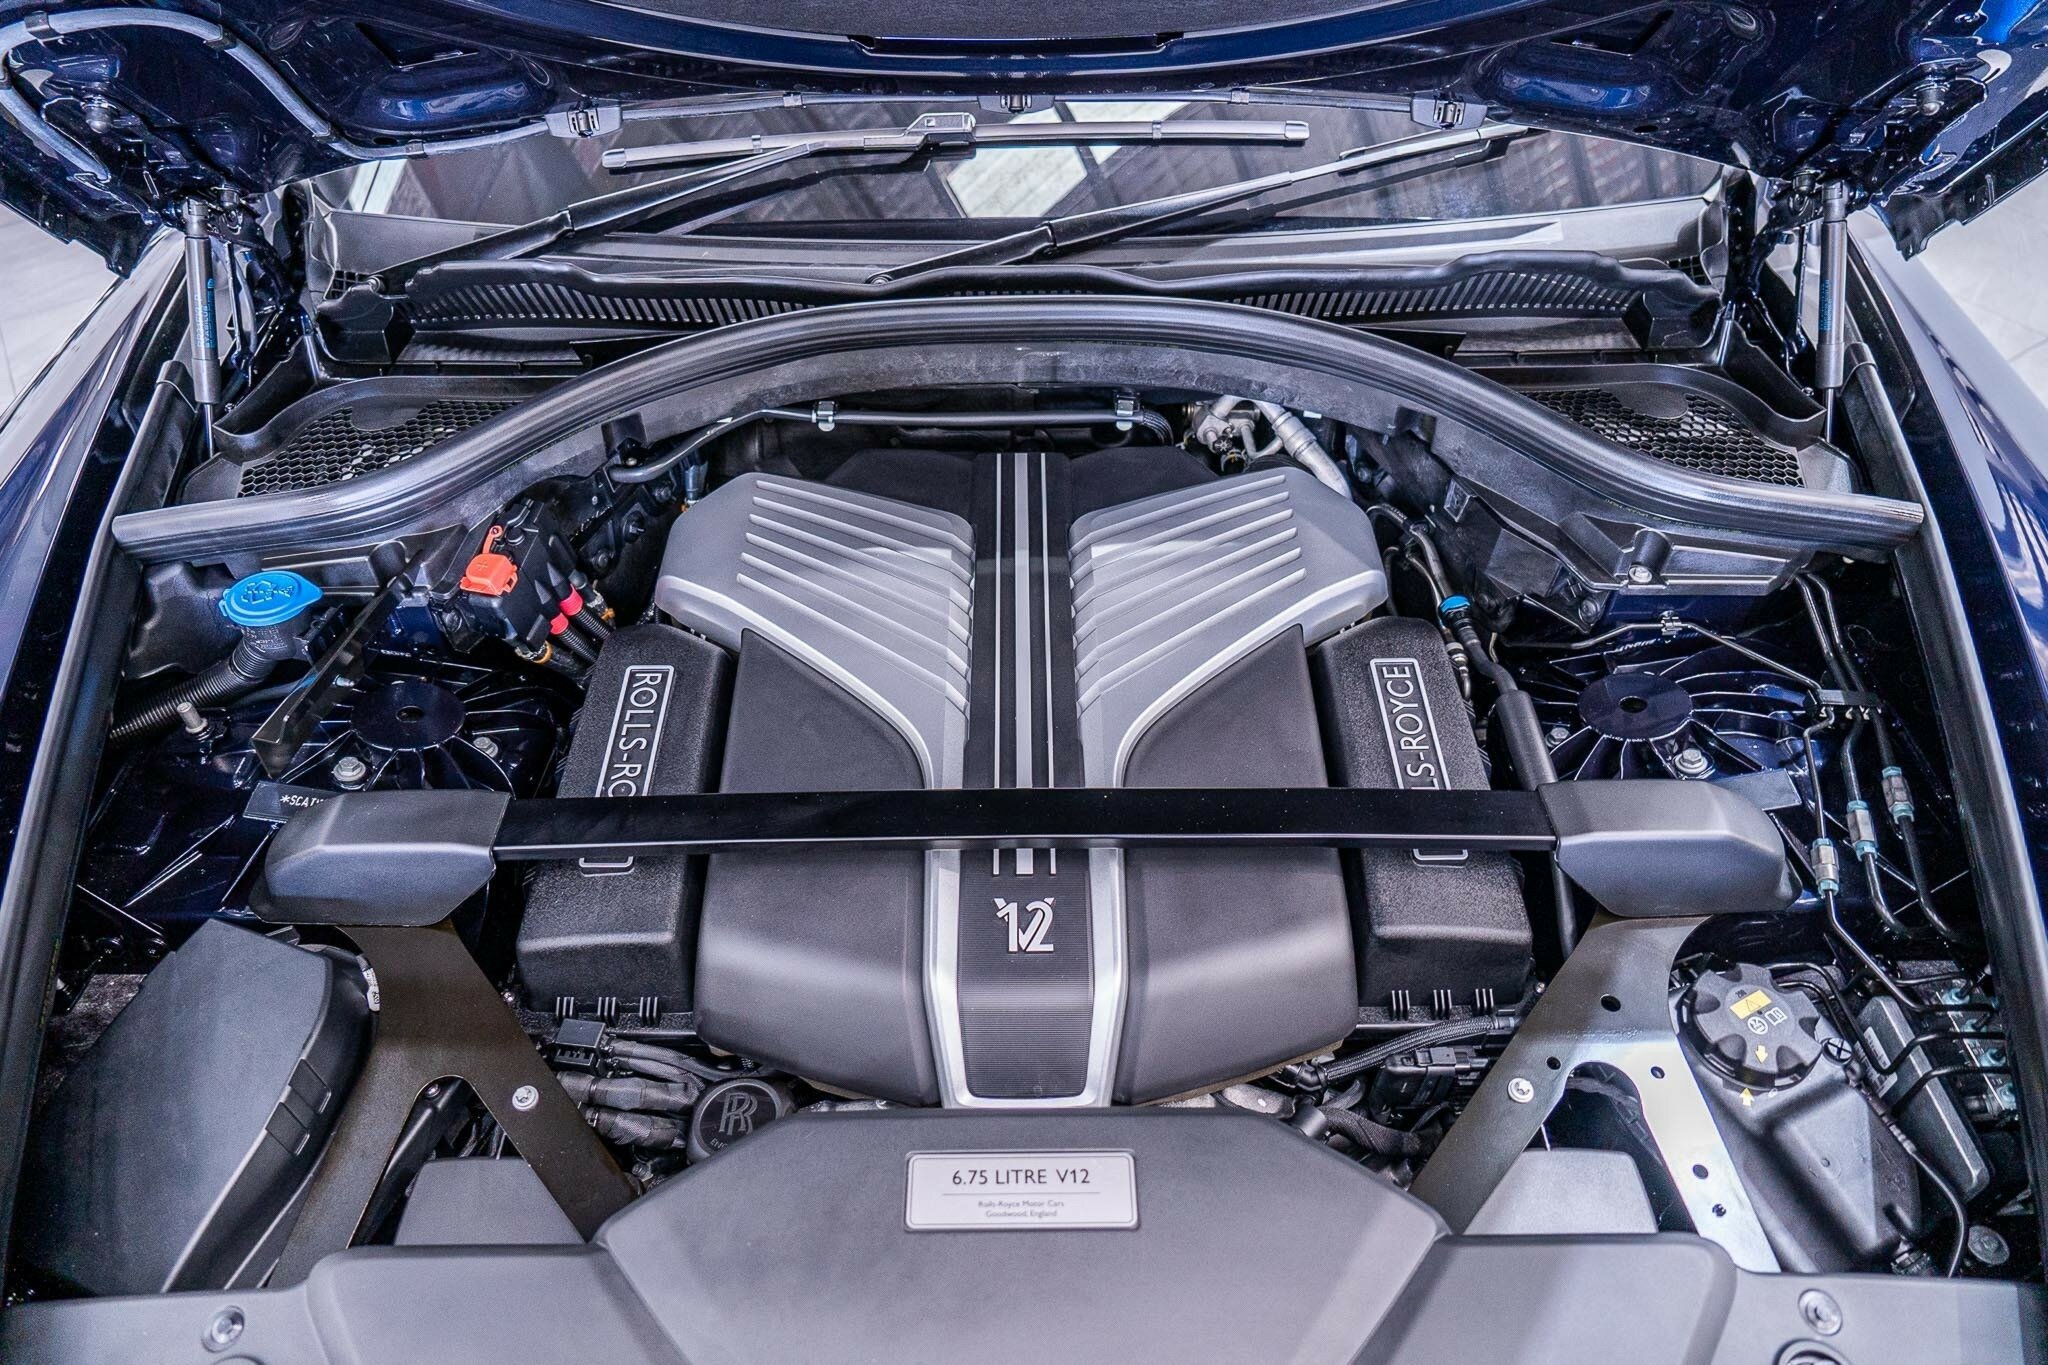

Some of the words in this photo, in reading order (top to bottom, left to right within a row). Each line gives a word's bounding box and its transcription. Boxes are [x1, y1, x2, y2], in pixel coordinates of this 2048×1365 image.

[607, 672, 662, 797] ROLLS-RO
[1382, 666, 1440, 789] LS-ROYCE
[952, 1170, 988, 1185] 6.75
[995, 1169, 1047, 1185] LITRE
[1055, 1168, 1090, 1184] V12
[1047, 1199, 1064, 1207] Cars
[1029, 1209, 1057, 1218] England
